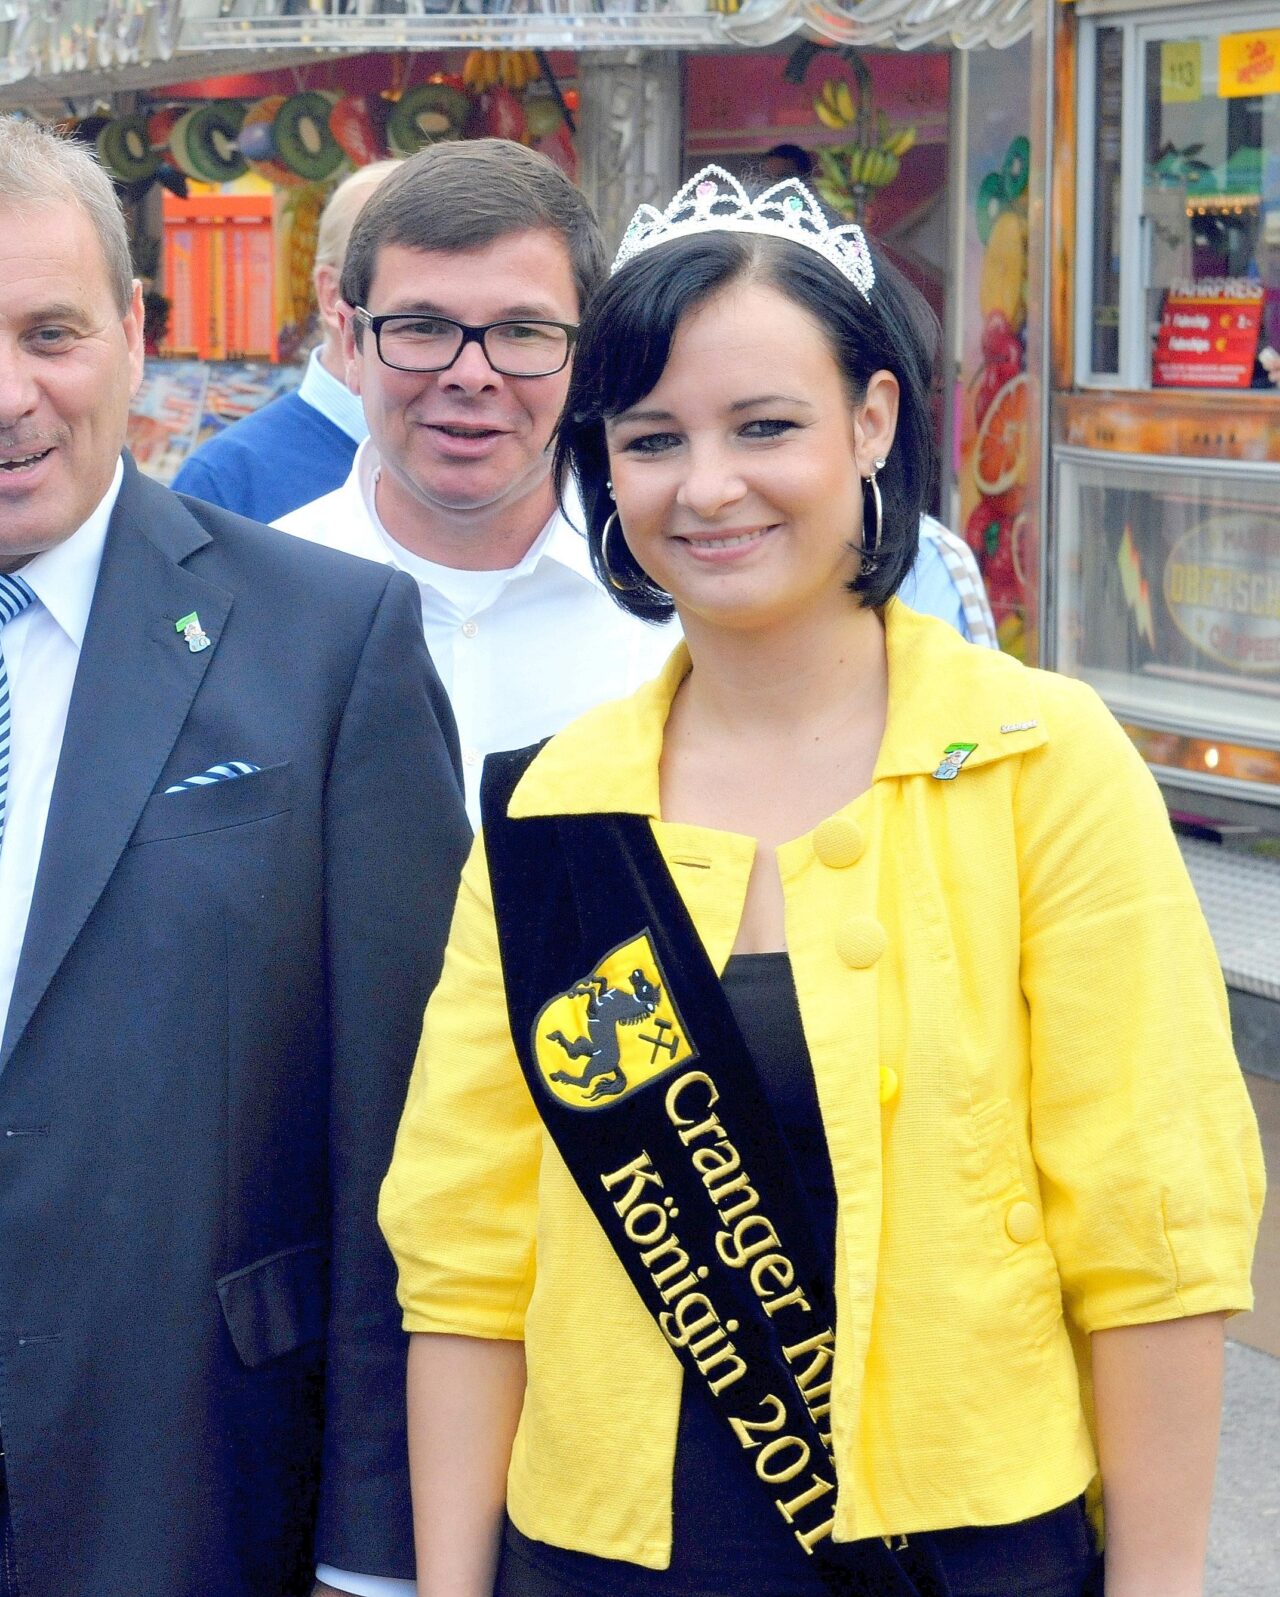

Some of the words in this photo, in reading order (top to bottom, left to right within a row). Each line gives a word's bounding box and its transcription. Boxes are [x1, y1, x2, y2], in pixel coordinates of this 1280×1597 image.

[600, 1149, 748, 1397] Königin
[728, 1393, 835, 1556] 2011
[665, 1070, 811, 1318] Cranger
